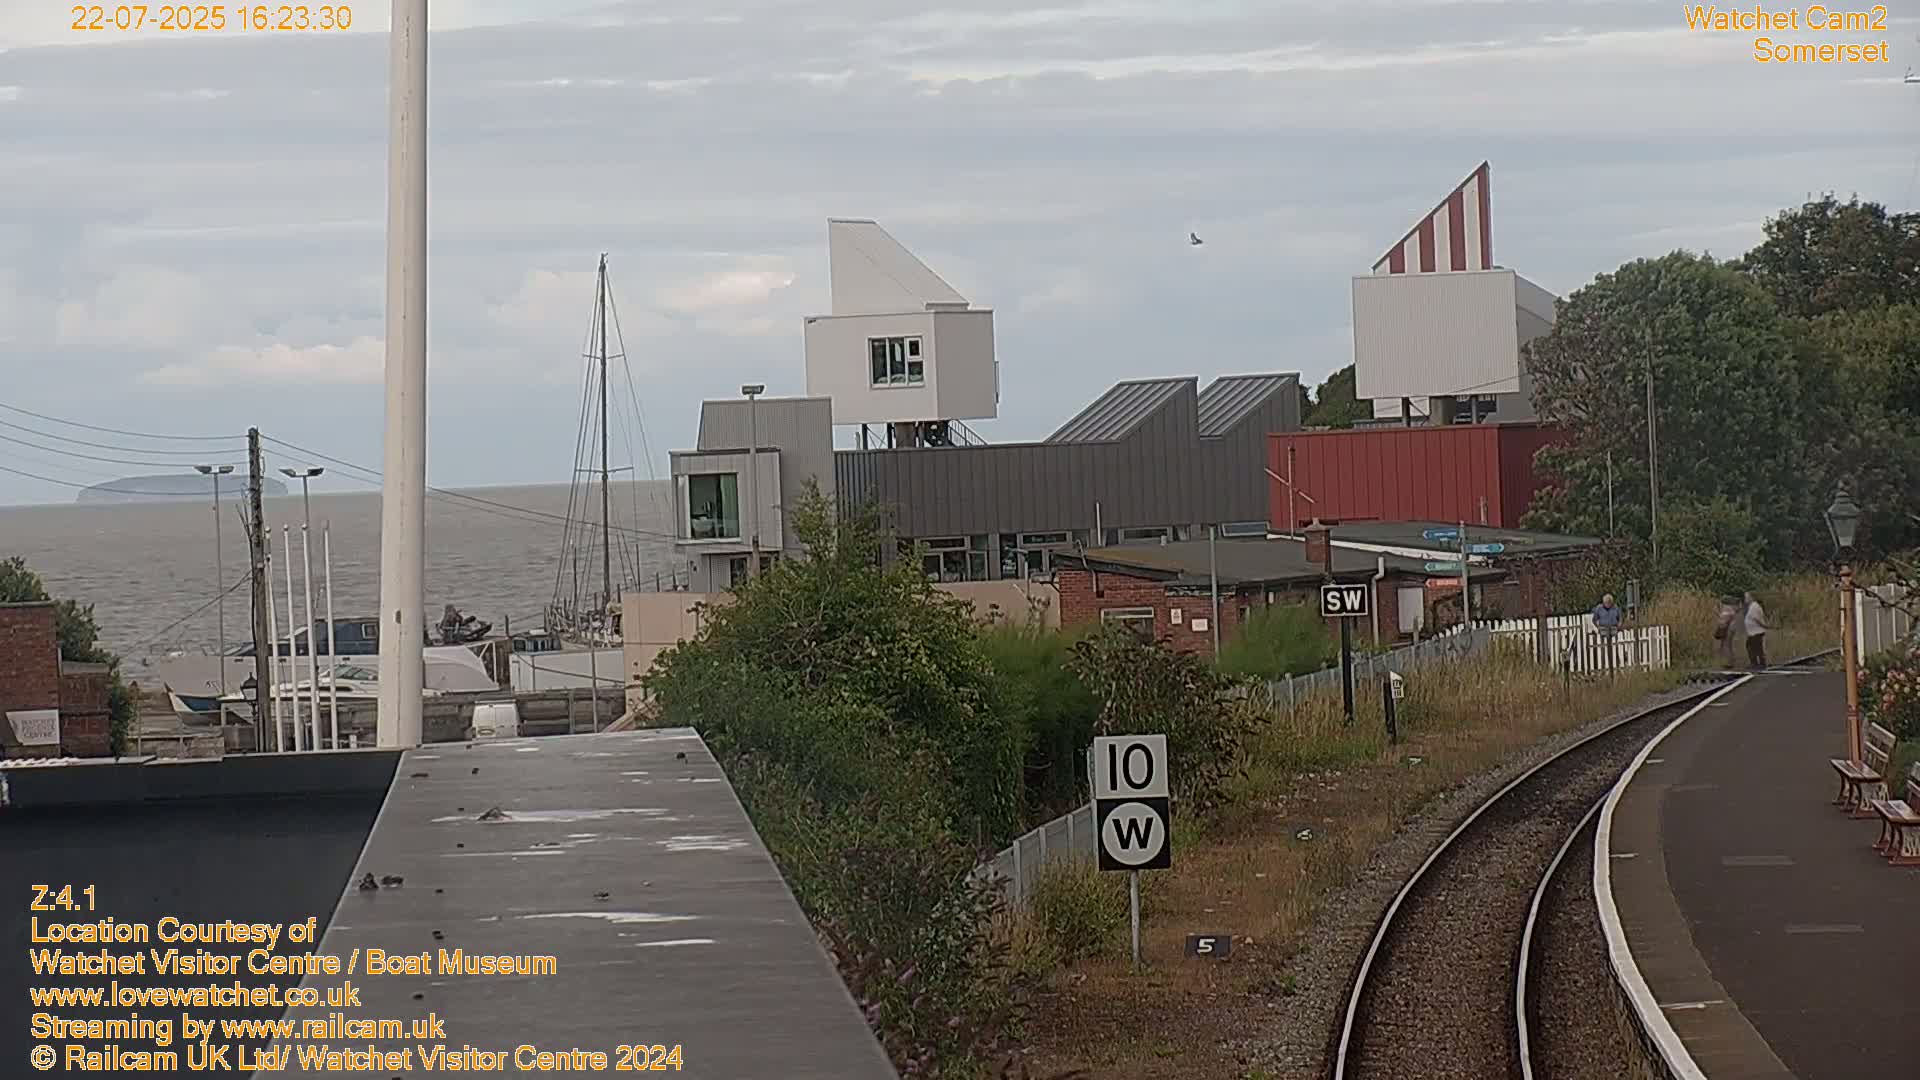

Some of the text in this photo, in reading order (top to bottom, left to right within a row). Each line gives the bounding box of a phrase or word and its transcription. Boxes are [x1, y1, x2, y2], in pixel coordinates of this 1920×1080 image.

[1327, 590, 1361, 611] SW
[1109, 743, 1154, 790] 10
[1112, 817, 1154, 850] W
[1197, 938, 1215, 954] 5
